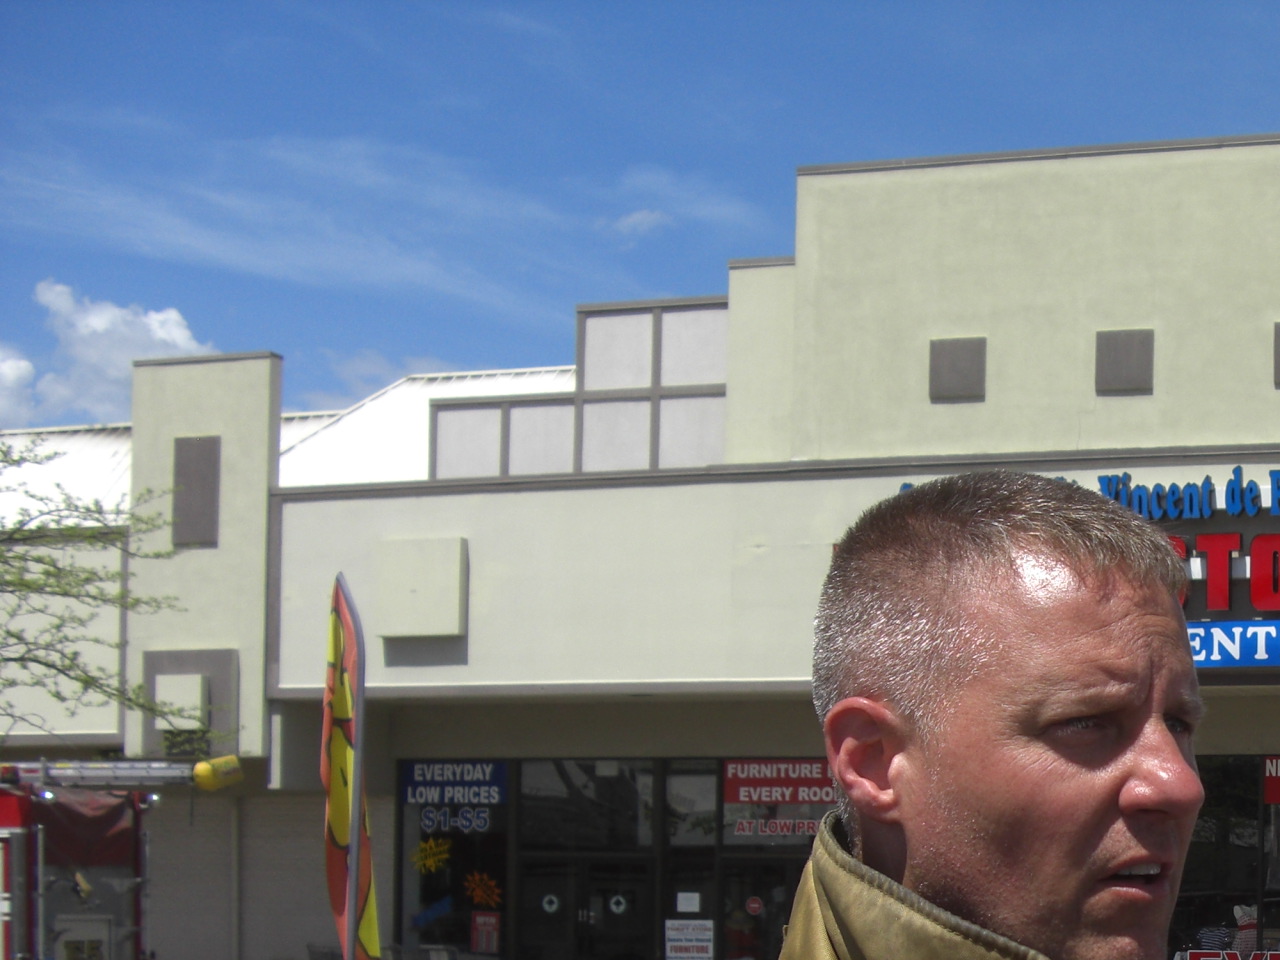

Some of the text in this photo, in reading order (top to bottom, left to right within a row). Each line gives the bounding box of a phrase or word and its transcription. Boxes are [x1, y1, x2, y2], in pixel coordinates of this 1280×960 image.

[1097, 470, 1213, 521] Vincent
[1225, 466, 1257, 517] de
[414, 763, 493, 782] EVERYDAY
[727, 763, 822, 778] FURNITURE
[407, 785, 500, 804] LOW PRICES
[739, 786, 838, 802] EVERY ROO
[420, 806, 490, 834] $1-$5
[734, 820, 755, 836] AT
[758, 820, 792, 836] LOW
